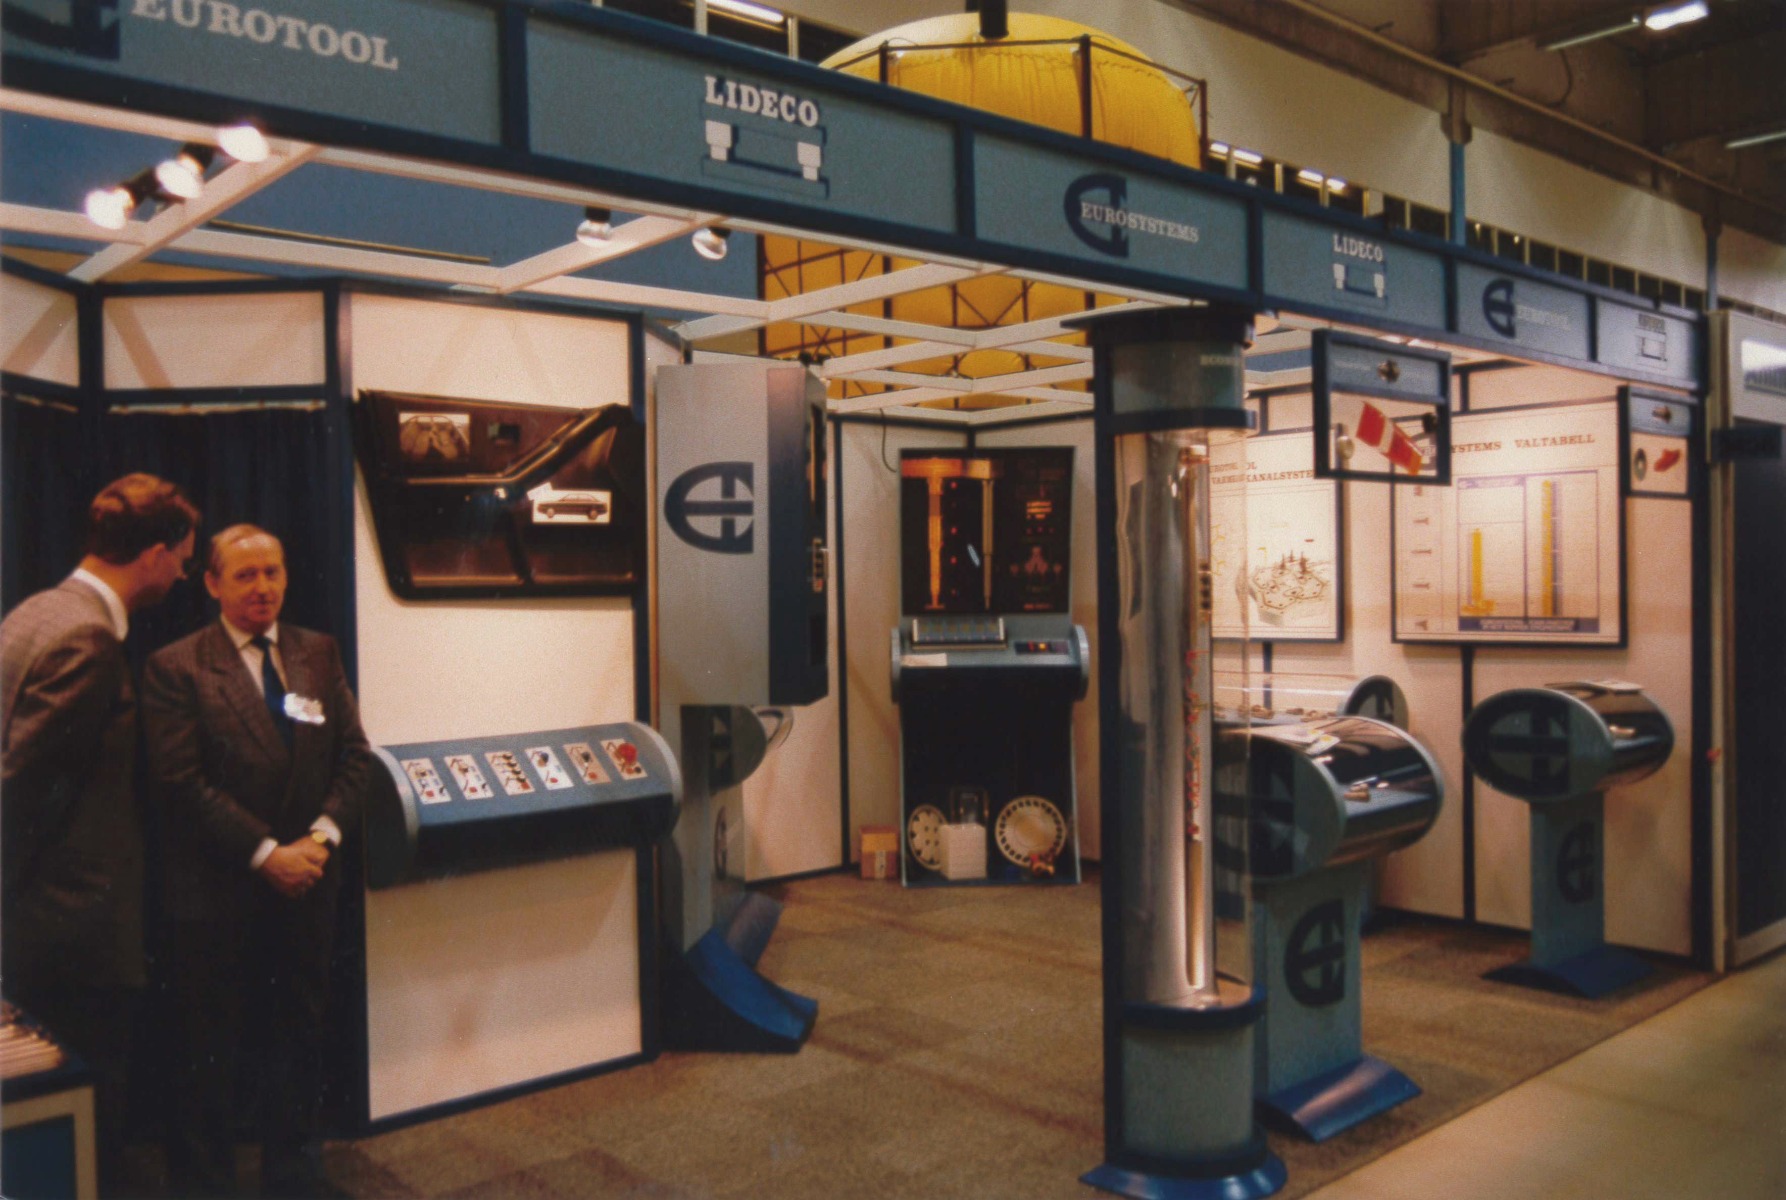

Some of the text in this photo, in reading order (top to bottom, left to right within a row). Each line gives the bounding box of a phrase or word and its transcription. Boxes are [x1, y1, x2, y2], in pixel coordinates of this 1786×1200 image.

[131, 0, 398, 70] EUROTOOL
[704, 76, 819, 127] LIDECO
[1080, 202, 1199, 243] EUROSYSTEMS
[1333, 233, 1383, 262] LIDECO
[1452, 434, 1596, 454] YSTEMS VALTABELL
